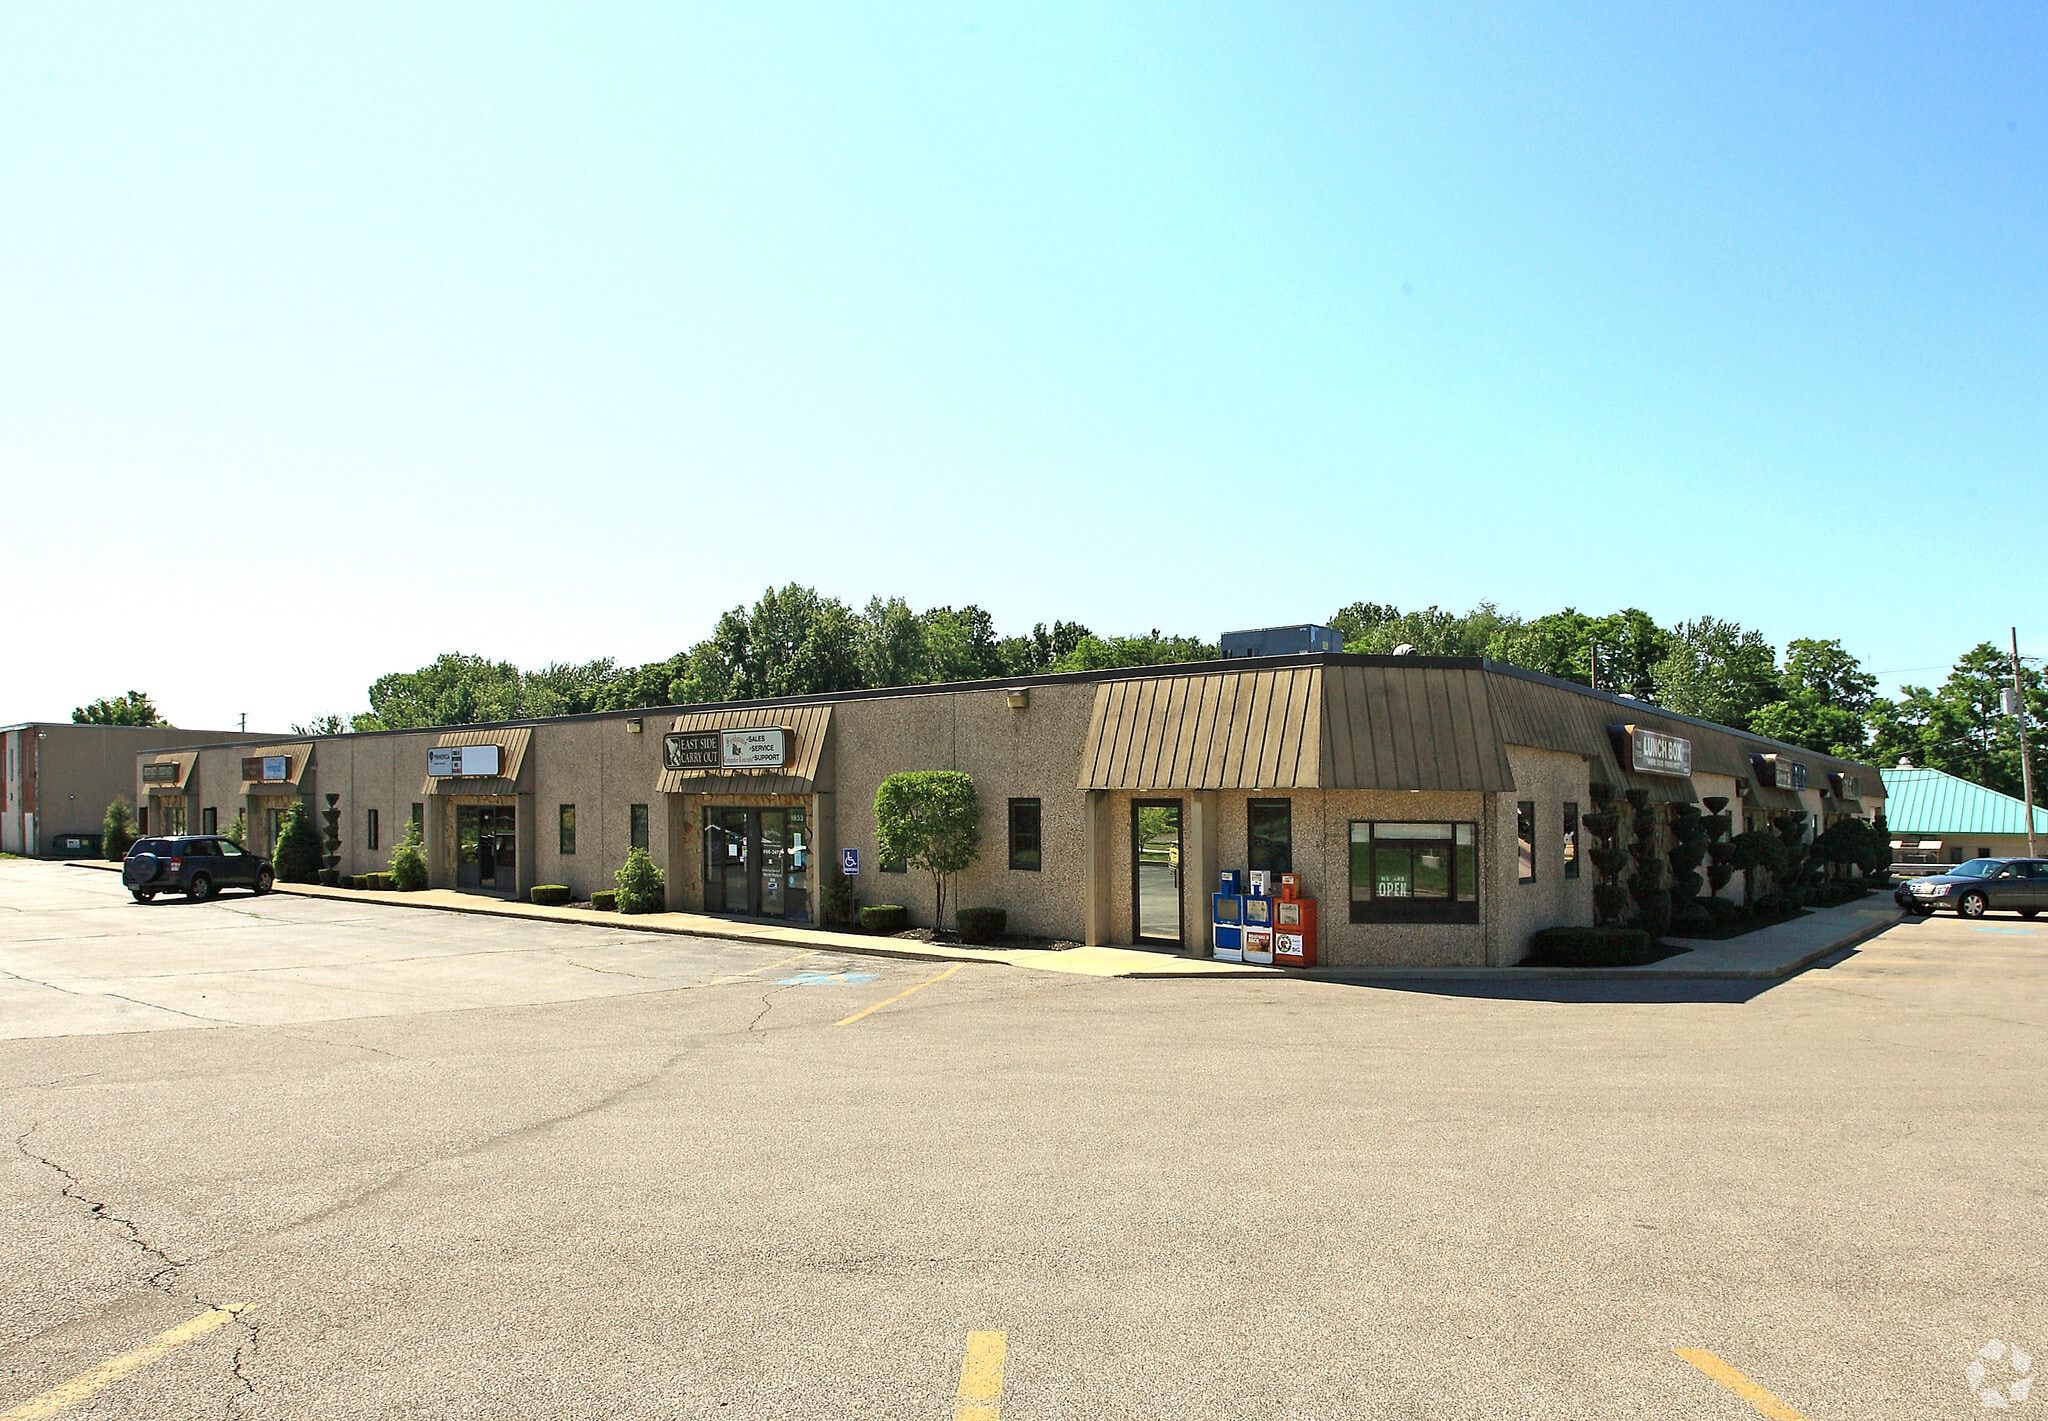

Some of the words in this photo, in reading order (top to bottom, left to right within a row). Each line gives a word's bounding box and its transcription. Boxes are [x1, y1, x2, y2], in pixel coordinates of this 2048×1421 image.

[681, 739, 699, 750] EAST
[700, 737, 717, 750] SIDE
[1643, 736, 1668, 759] LUNCH
[1668, 741, 1683, 762] BOX
[681, 751, 702, 764] CARRY
[703, 751, 718, 763] OUT
[1379, 882, 1407, 897] OPEN
